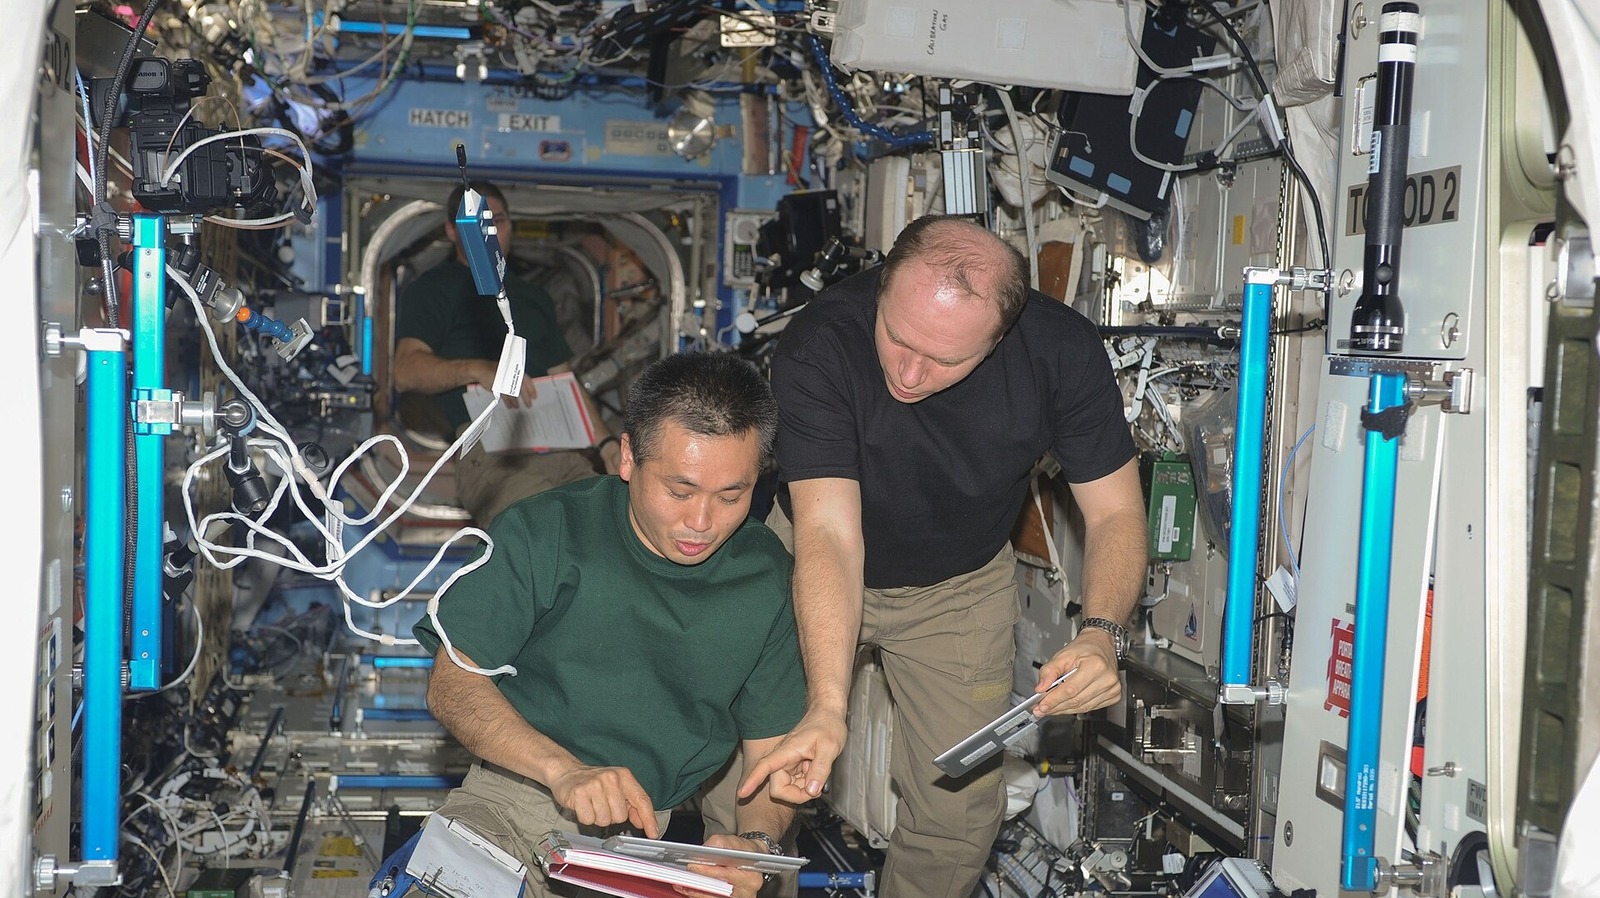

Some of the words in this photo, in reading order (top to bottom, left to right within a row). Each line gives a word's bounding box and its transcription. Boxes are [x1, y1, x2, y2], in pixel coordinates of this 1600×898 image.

[939, 14, 948, 31] GAS
[927, 9, 938, 55] CALIBRATION
[410, 111, 470, 127] HATCH
[509, 114, 549, 130] EXIT
[1442, 171, 1457, 221] 2
